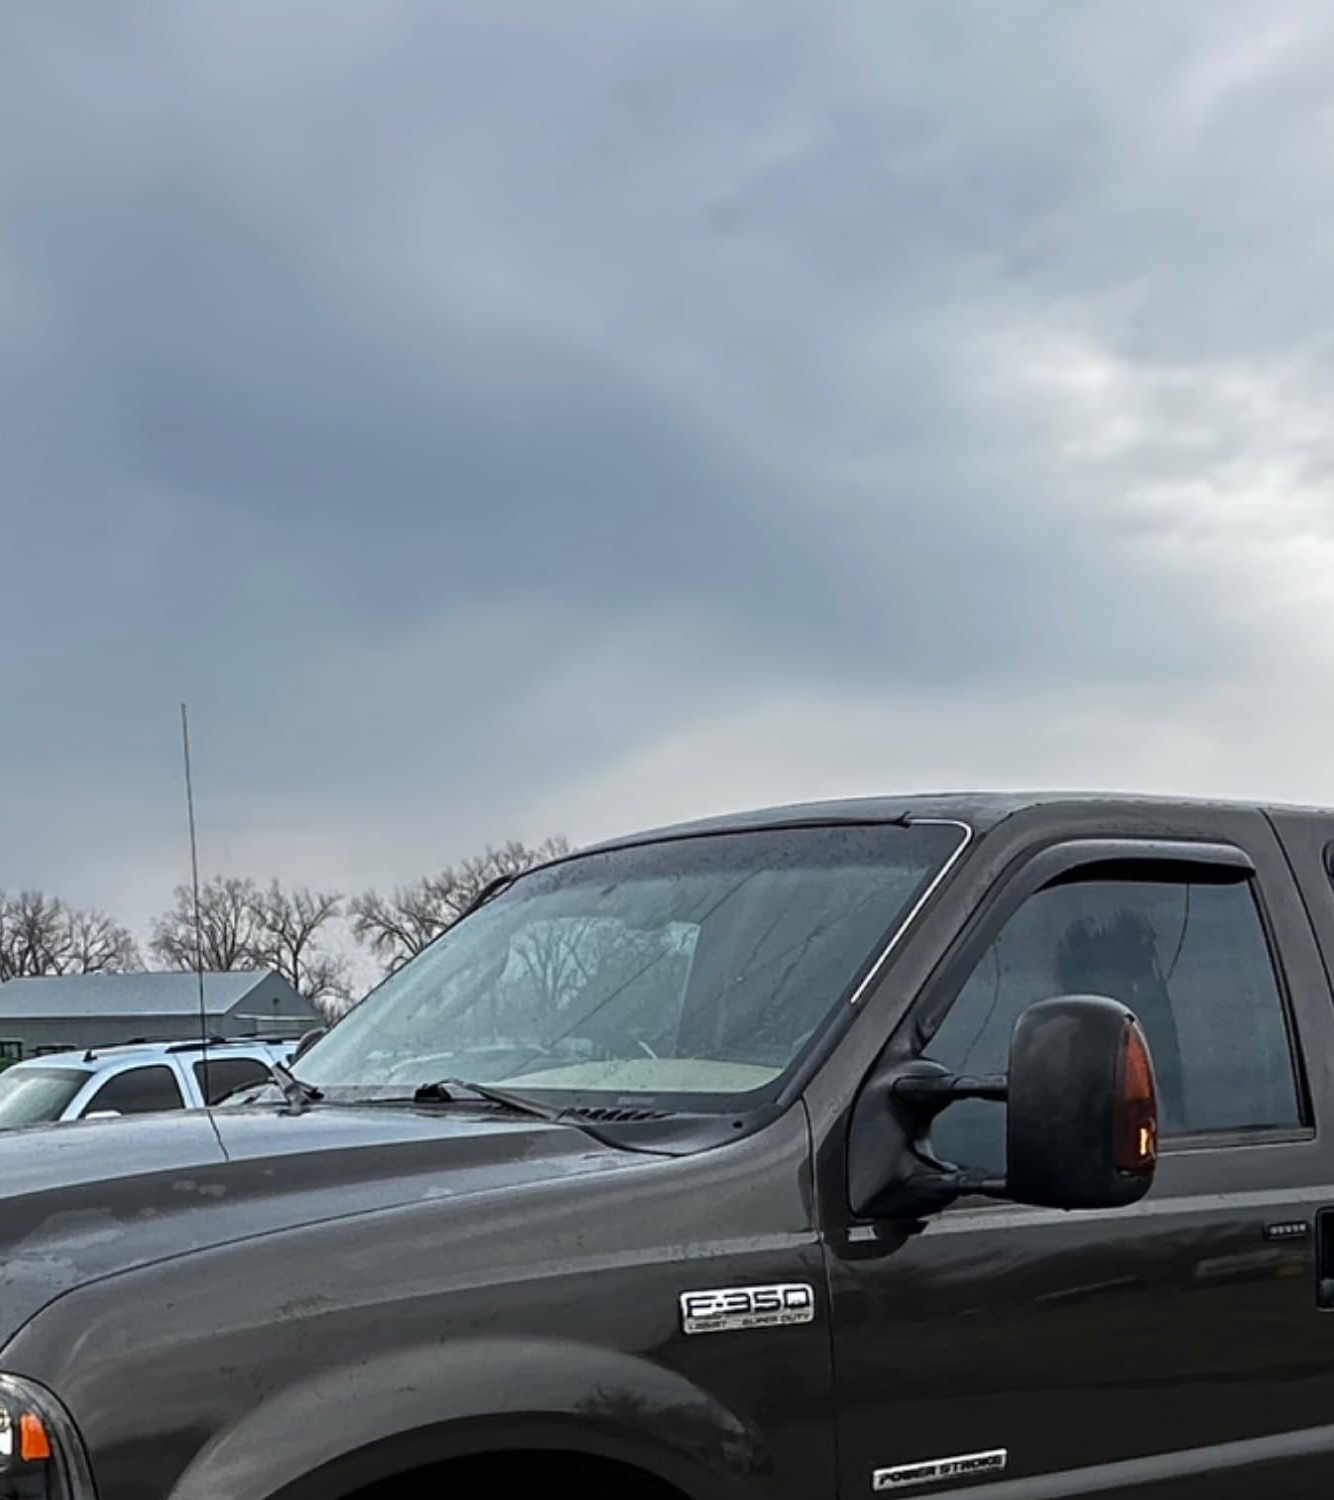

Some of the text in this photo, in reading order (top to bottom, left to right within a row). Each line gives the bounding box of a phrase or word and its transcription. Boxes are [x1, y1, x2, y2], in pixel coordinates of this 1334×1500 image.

[685, 1287, 811, 1318] F-350
[741, 1315, 778, 1327] SUPER
[780, 1312, 811, 1323] DUTY
[878, 1466, 935, 1486] POWER
